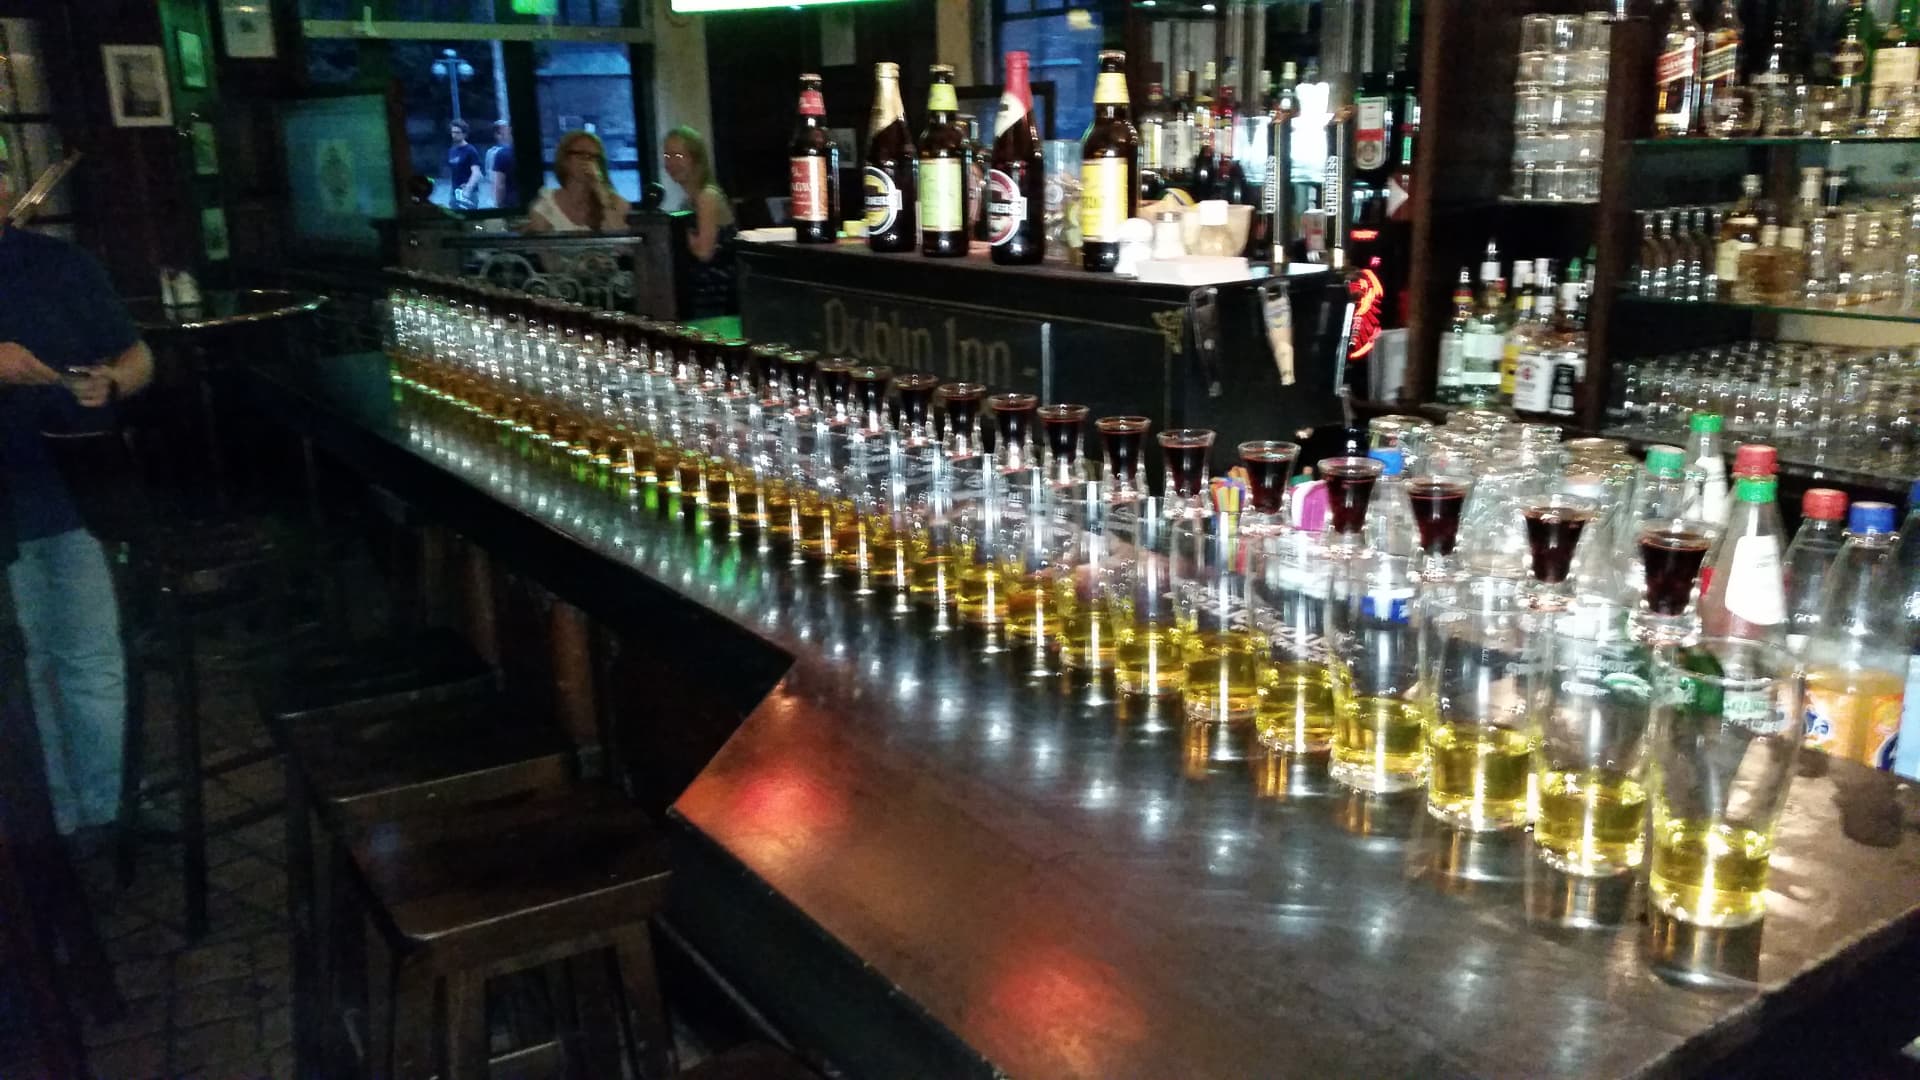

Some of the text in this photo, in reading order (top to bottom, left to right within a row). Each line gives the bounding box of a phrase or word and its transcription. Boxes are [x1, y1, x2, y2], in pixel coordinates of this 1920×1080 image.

[1263, 154, 1276, 214] GUINNESS
[1325, 154, 1338, 216] GUINNESS
[823, 297, 1012, 388] Dublin Inn
